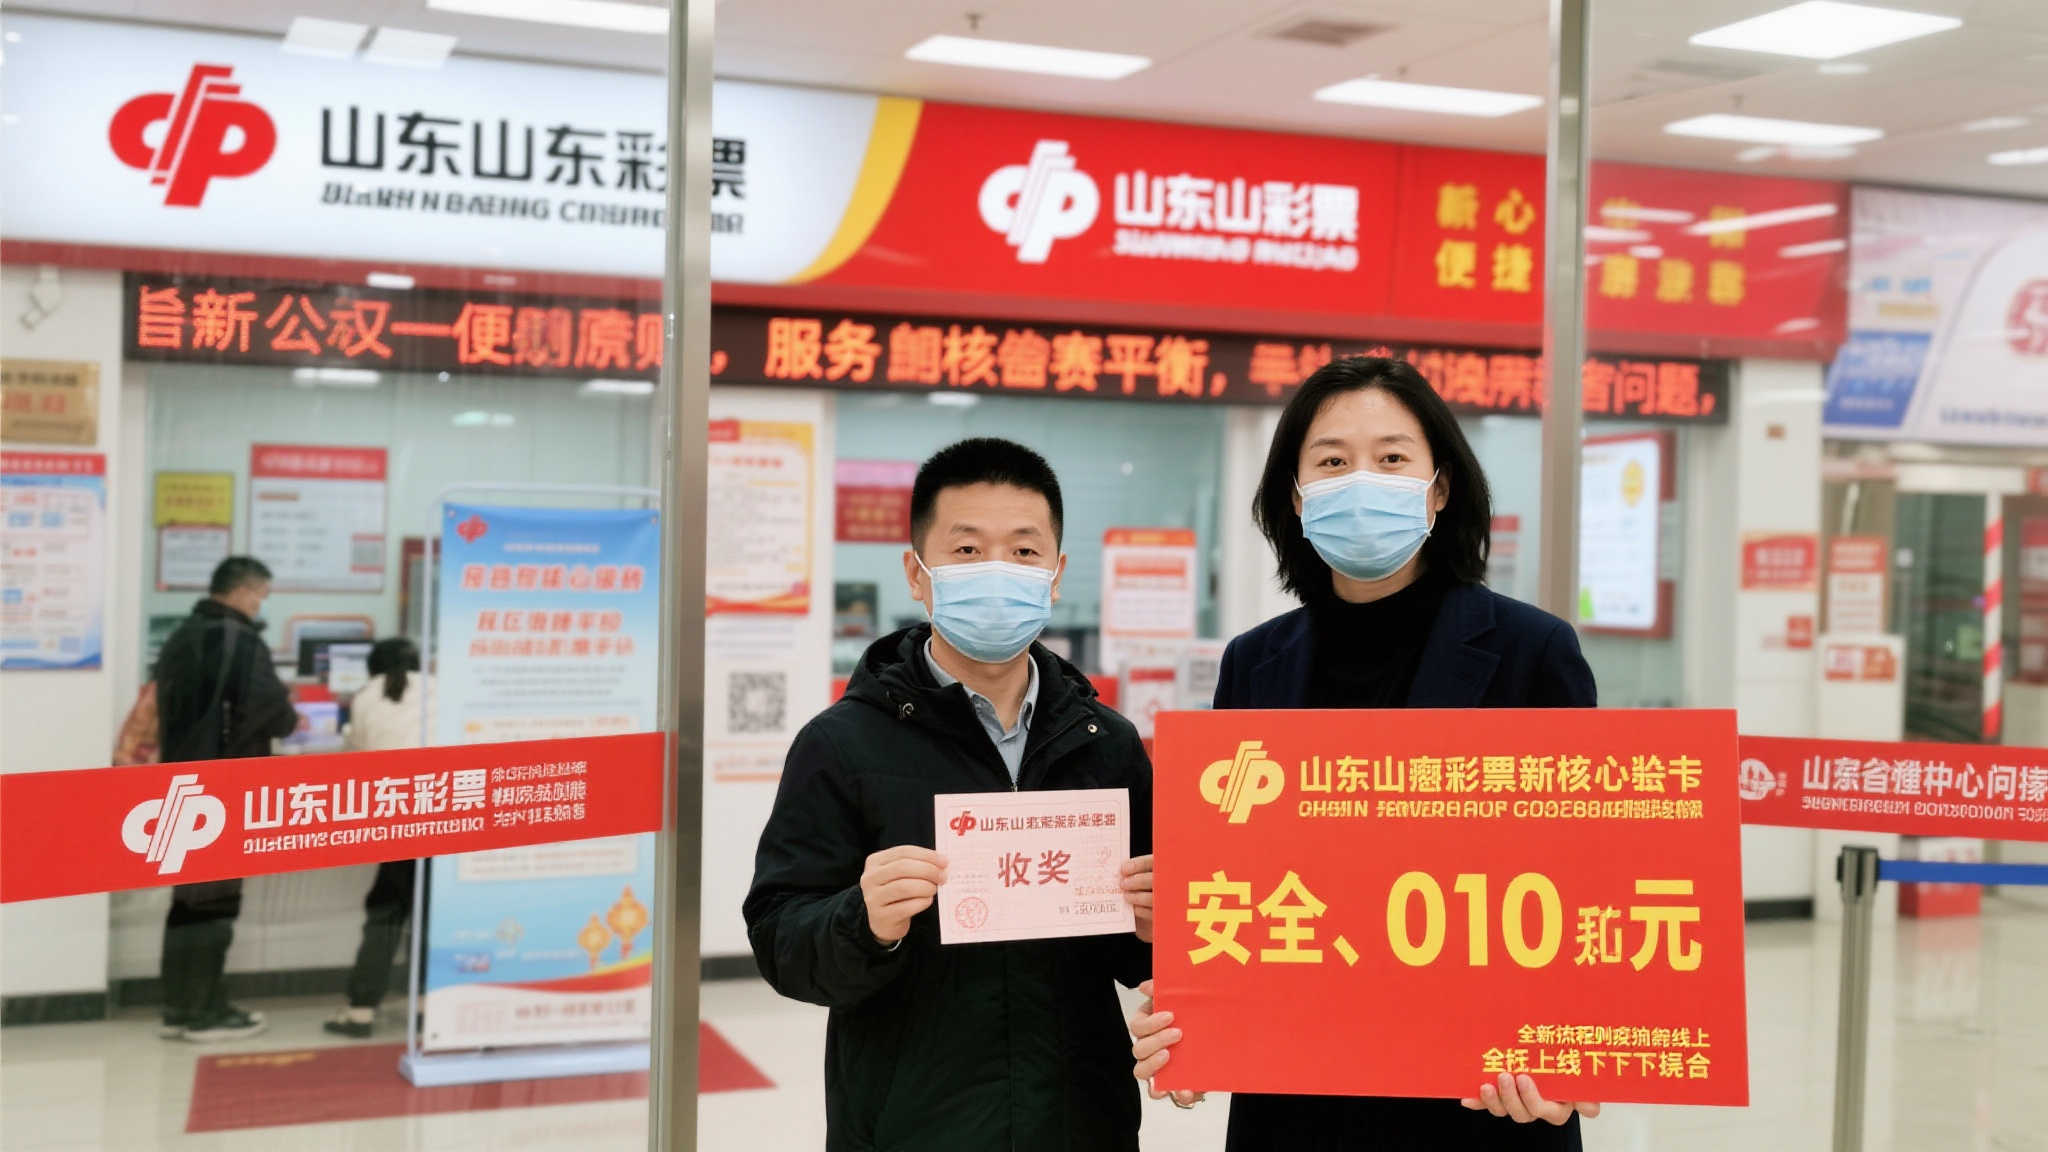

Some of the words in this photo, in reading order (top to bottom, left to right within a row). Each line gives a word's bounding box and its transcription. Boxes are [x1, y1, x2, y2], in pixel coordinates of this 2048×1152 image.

[1114, 170, 1360, 243] 山东山彩票
[243, 768, 487, 831] 山东山东彩票
[998, 849, 1071, 888] 收奖
